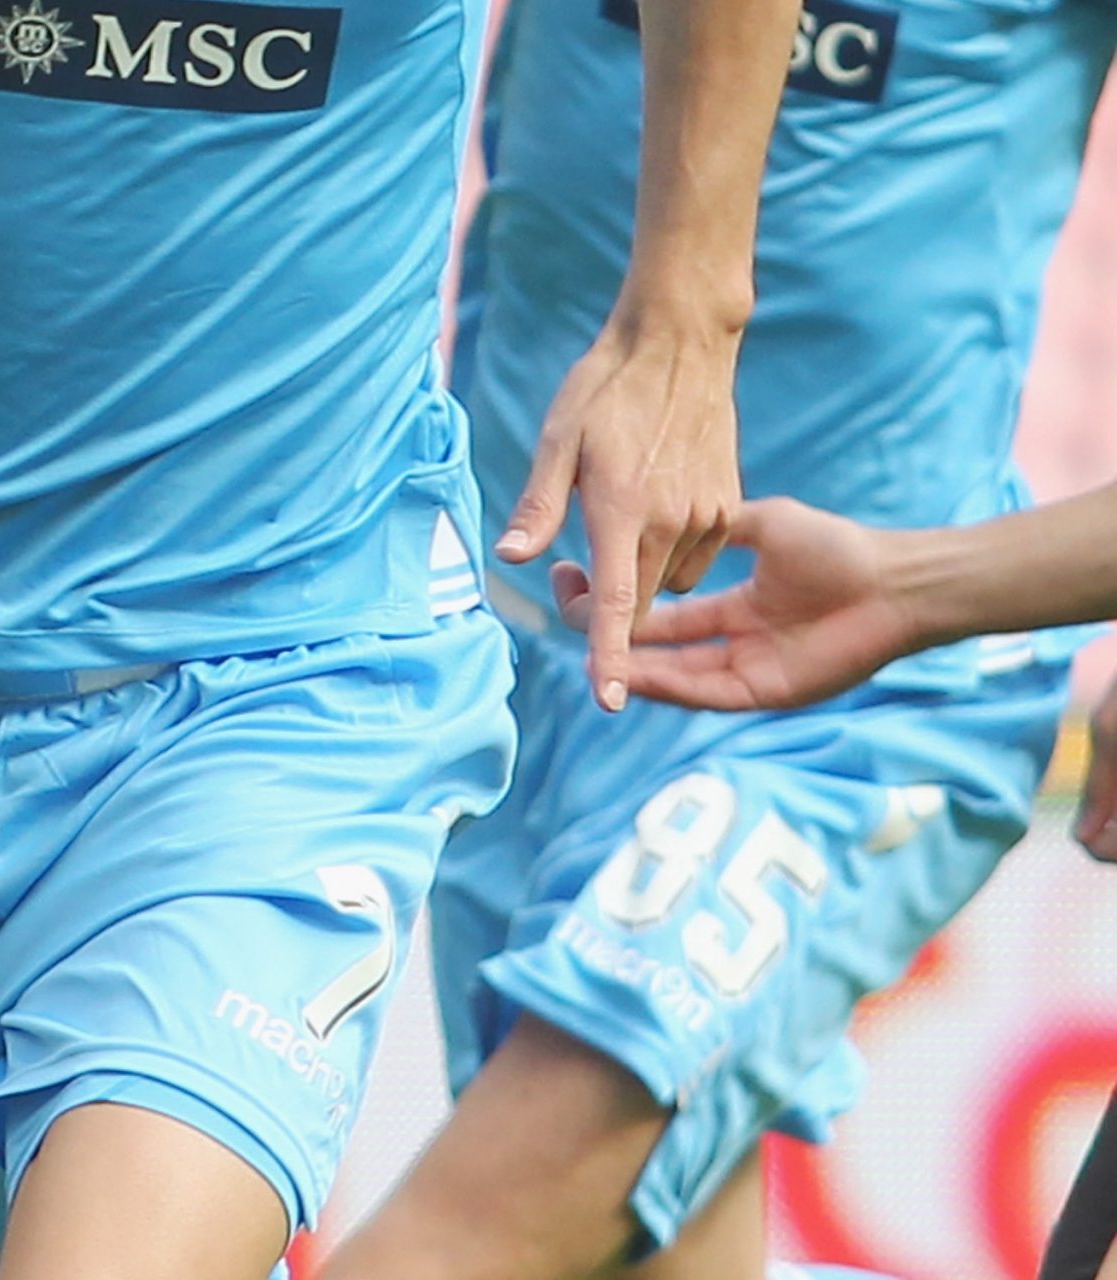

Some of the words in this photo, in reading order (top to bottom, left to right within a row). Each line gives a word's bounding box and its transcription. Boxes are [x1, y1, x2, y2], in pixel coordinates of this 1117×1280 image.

[85, 14, 312, 90] MSC
[302, 864, 396, 1040] 7
[593, 772, 827, 997] 85
